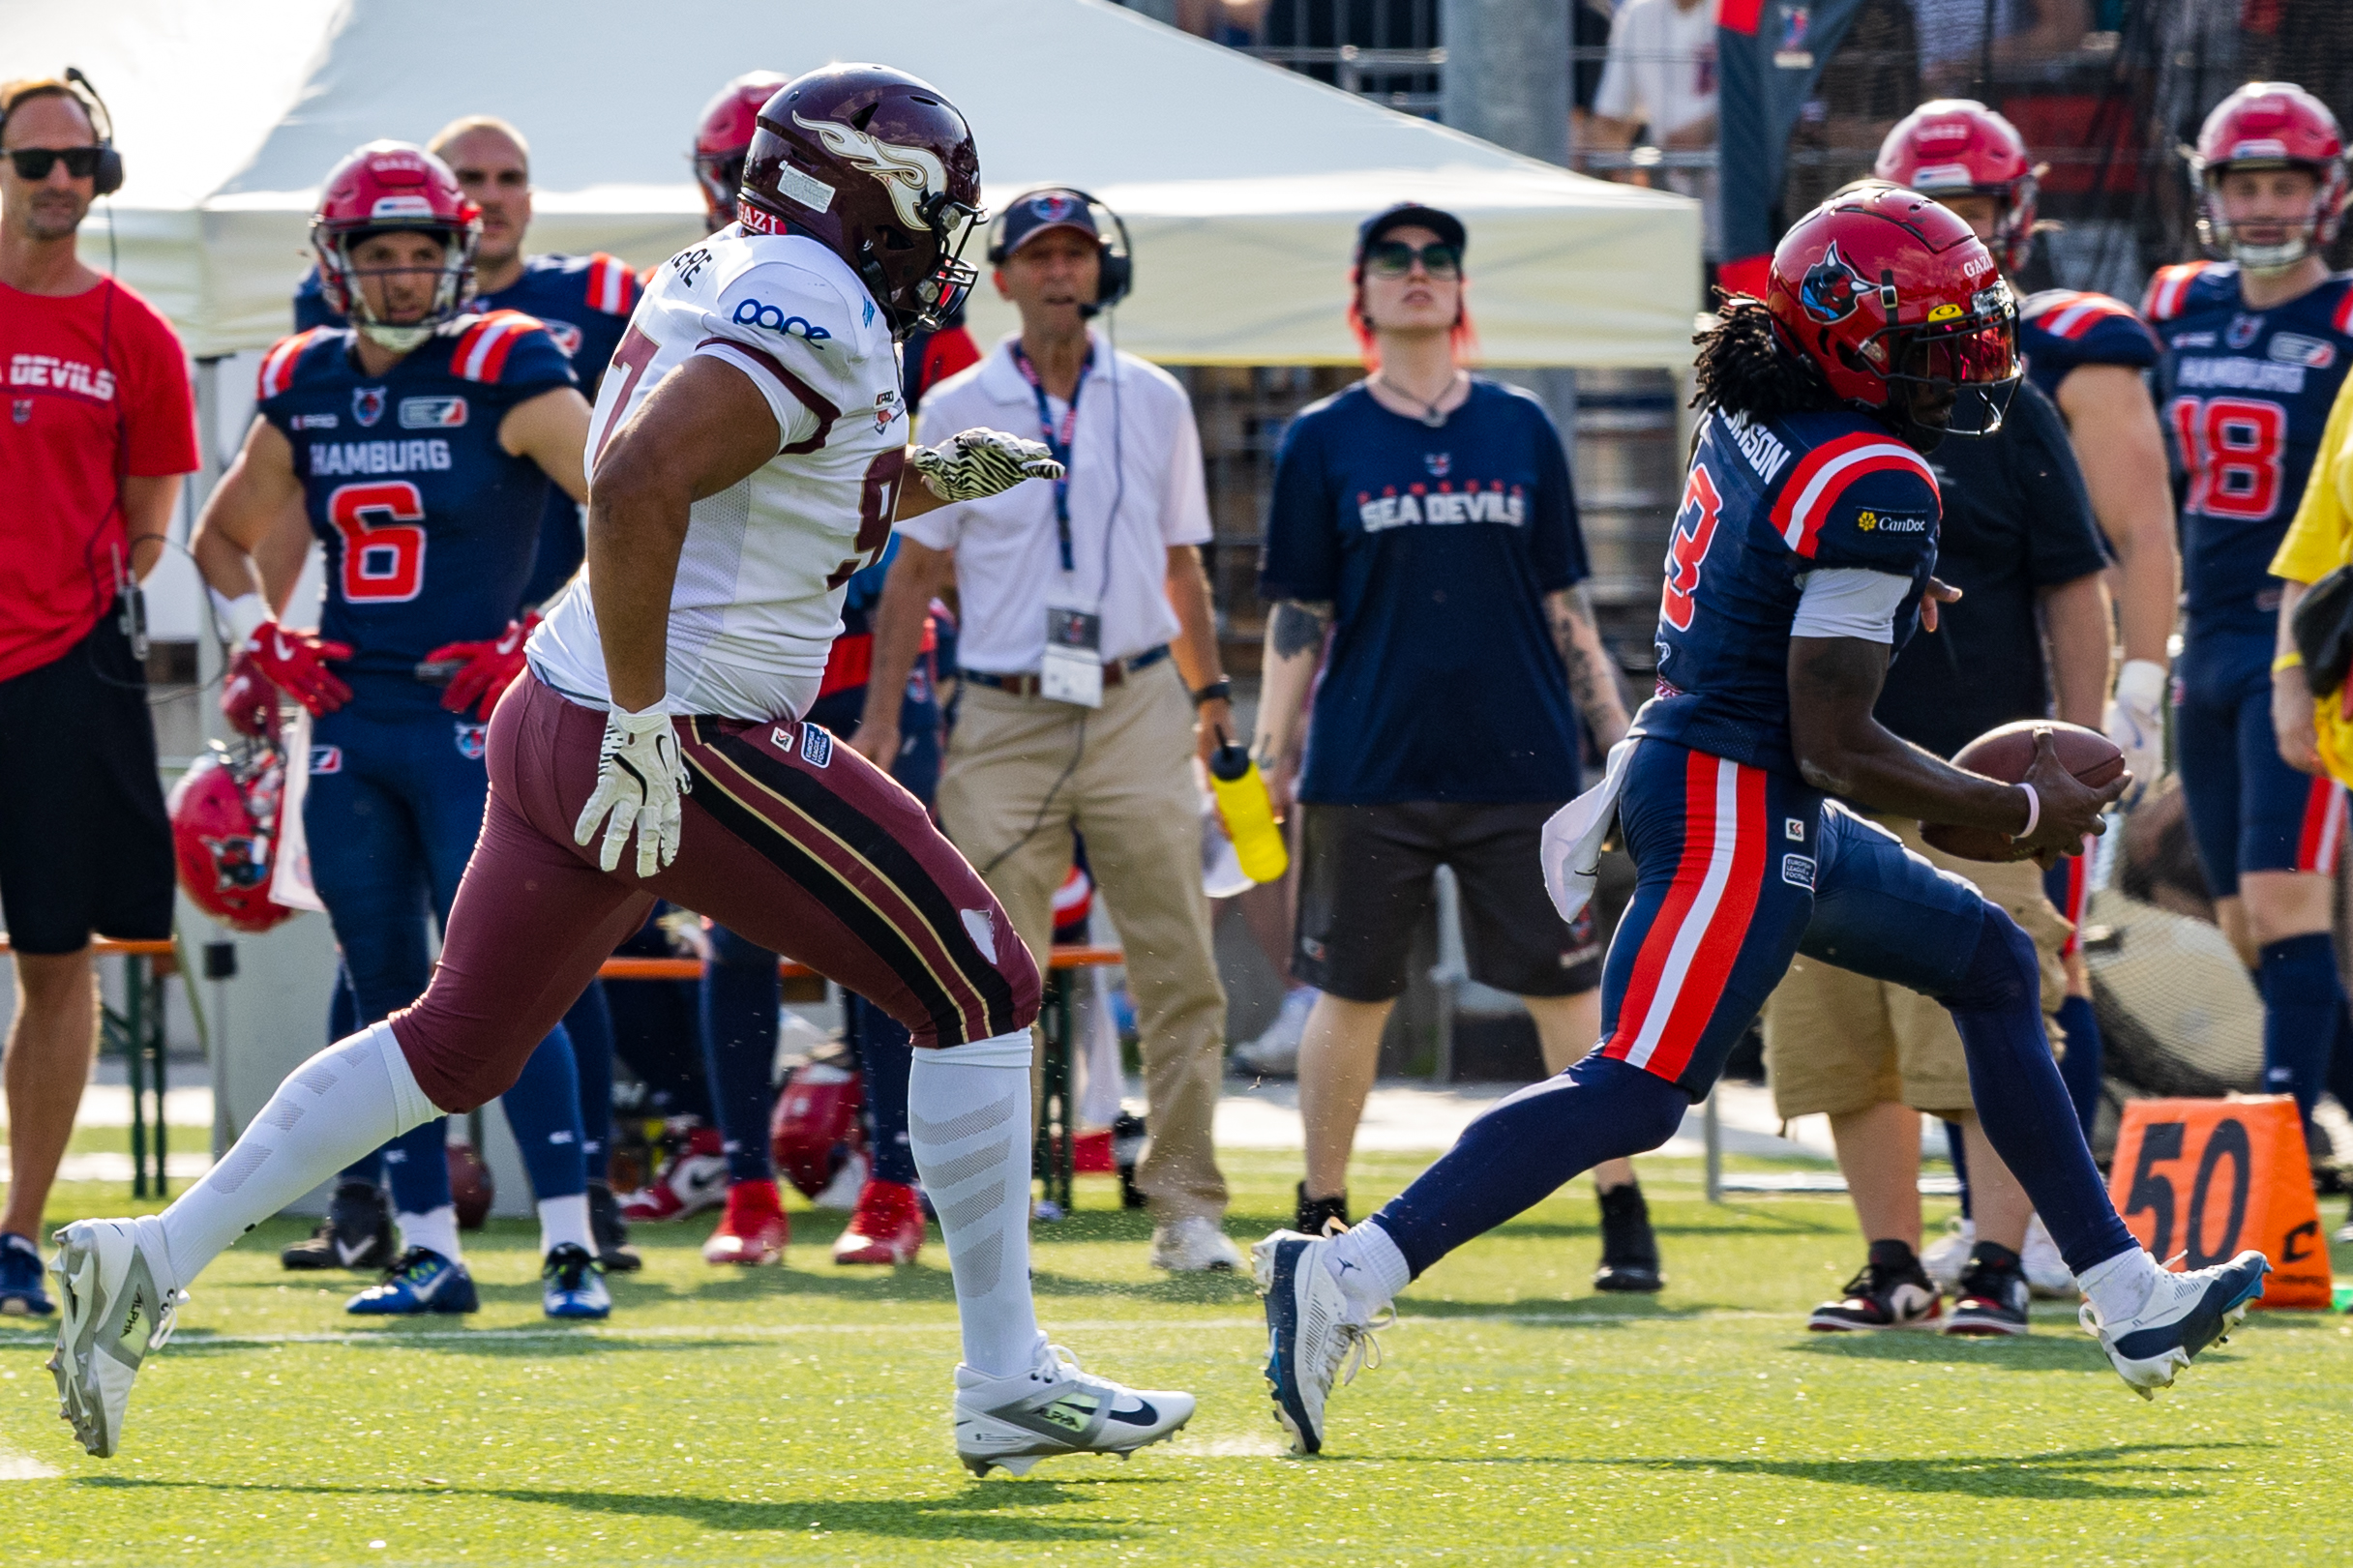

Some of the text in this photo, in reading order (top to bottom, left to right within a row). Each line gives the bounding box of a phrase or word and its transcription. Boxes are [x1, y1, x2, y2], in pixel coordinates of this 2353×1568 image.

[10, 353, 116, 401] DEVILS
[309, 439, 452, 475] HAMBURG
[825, 445, 907, 592] 9
[1358, 490, 1525, 532] SEA DEVILS
[2168, 396, 2287, 520] 18
[327, 480, 427, 604] 6
[1661, 462, 1724, 633] 3
[1879, 517, 1925, 532] CanDoc
[2124, 1118, 2251, 1273] 50
